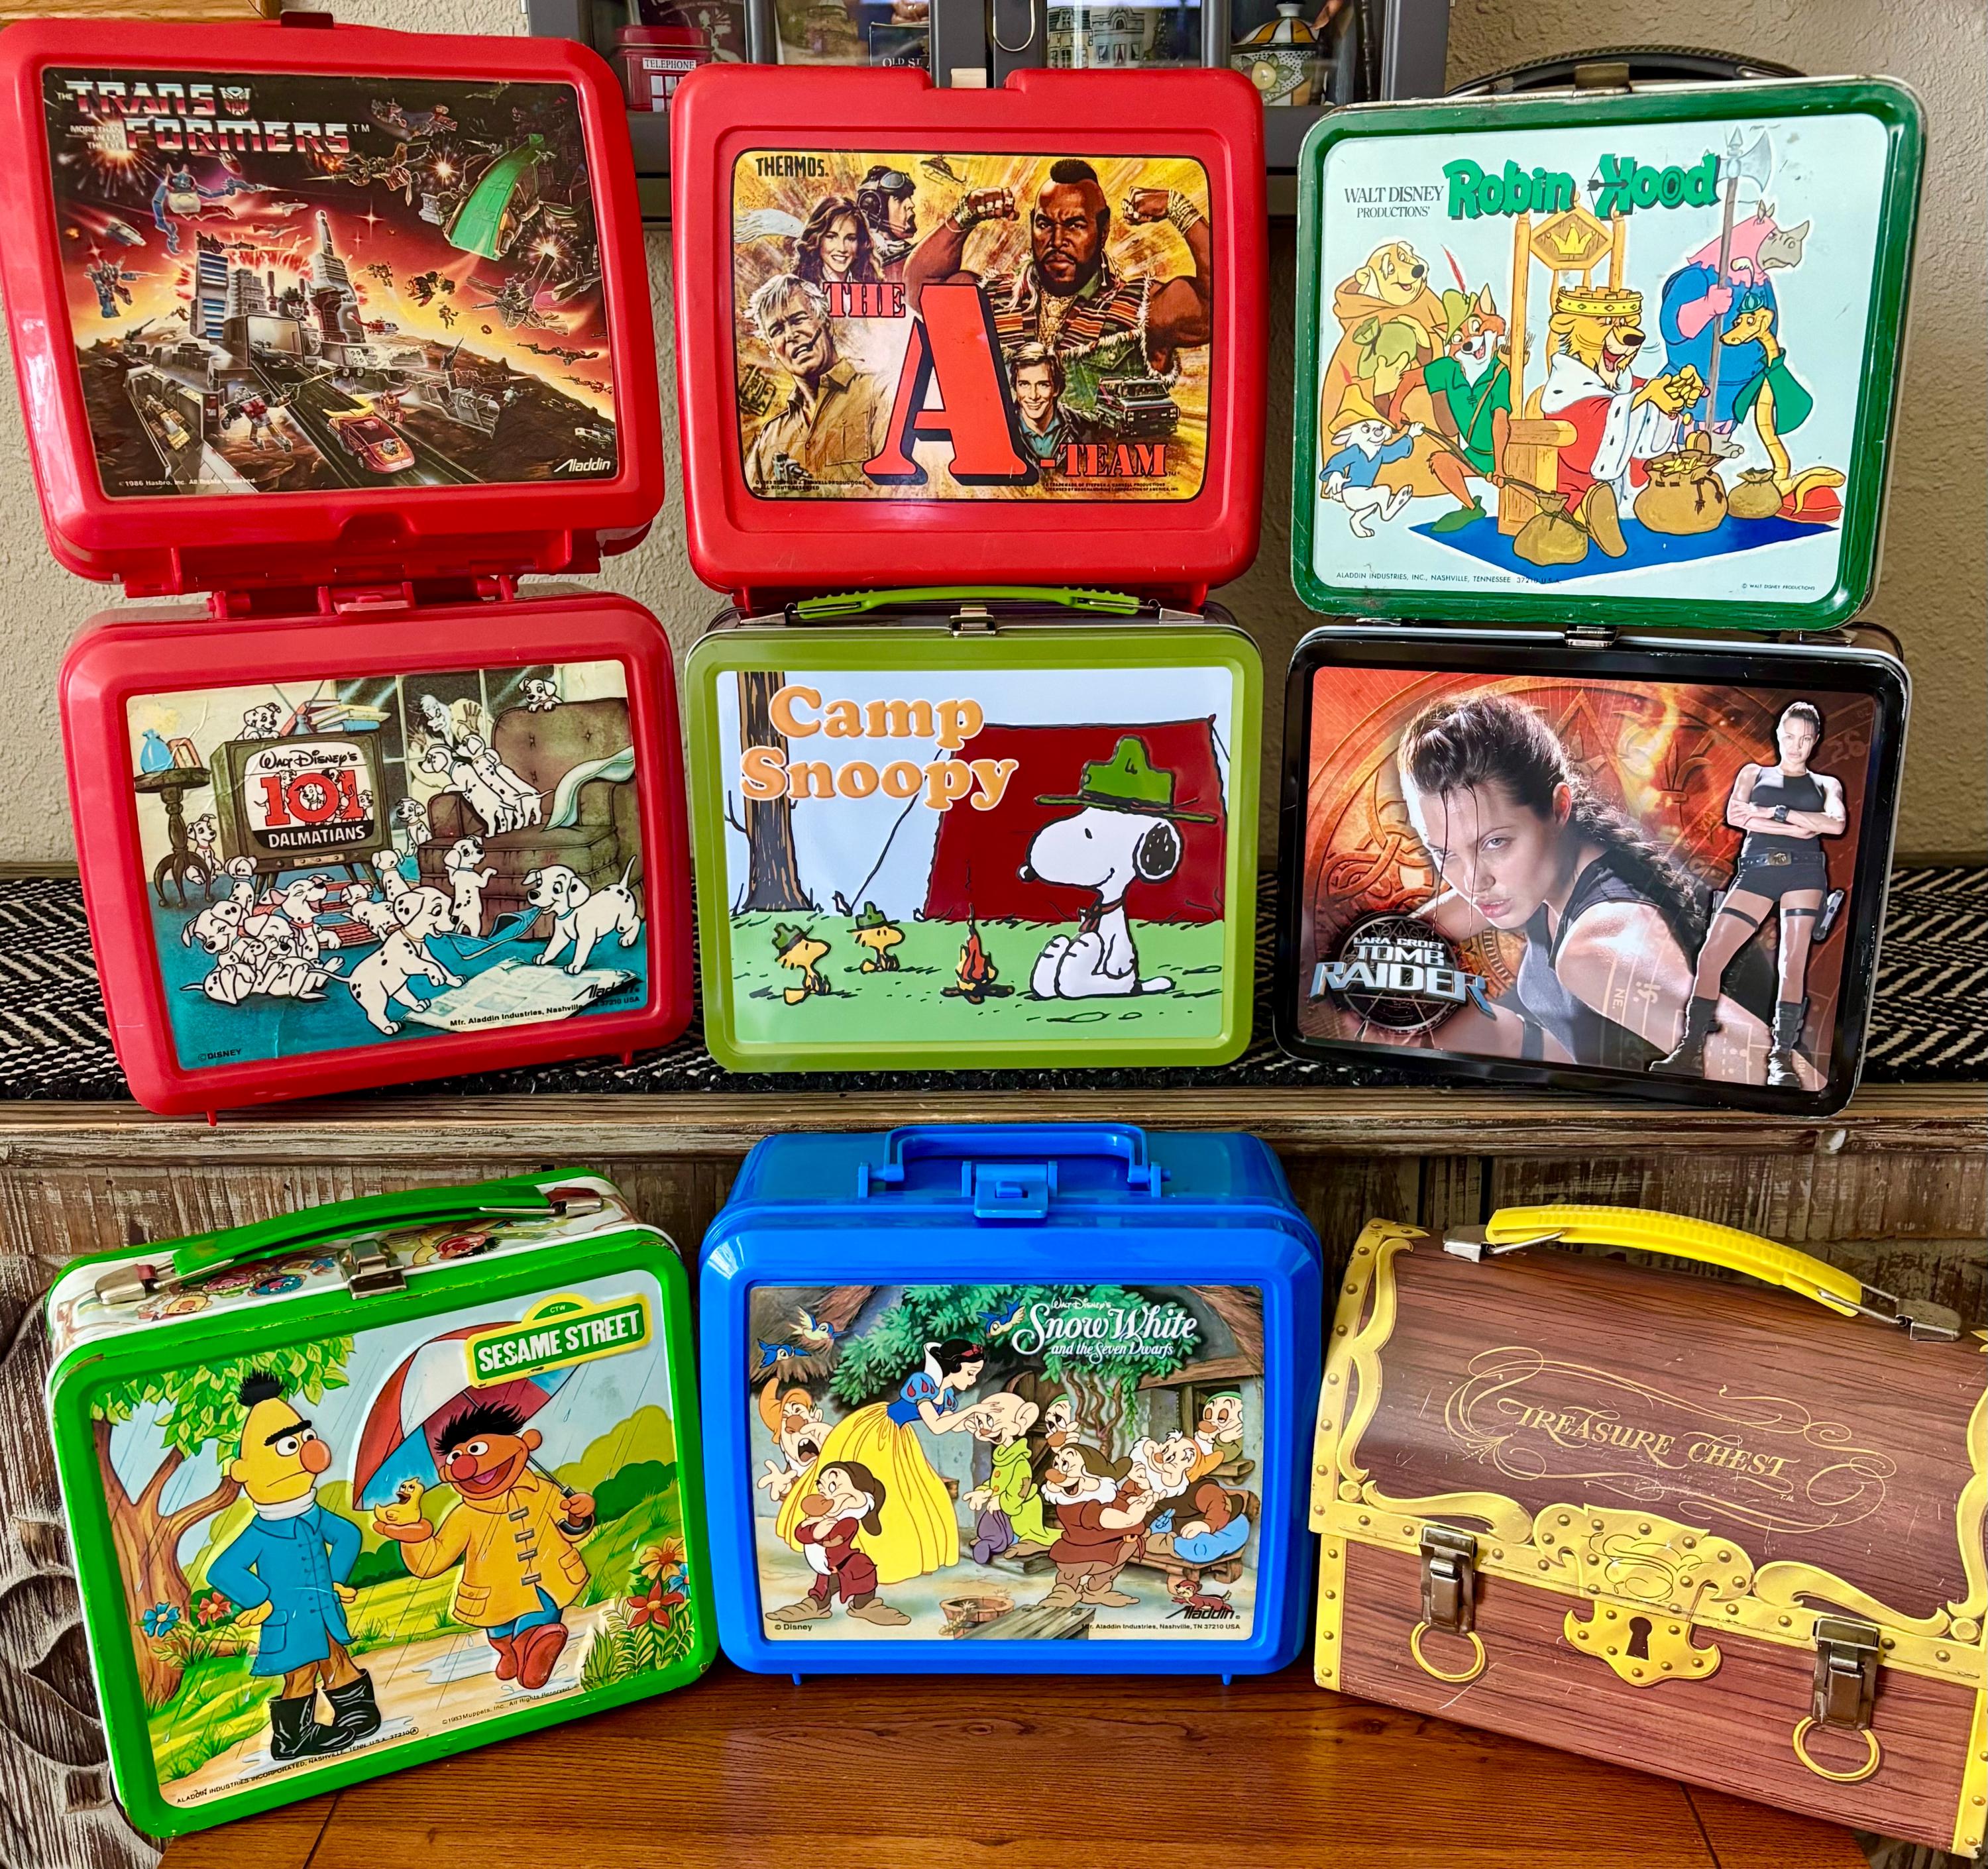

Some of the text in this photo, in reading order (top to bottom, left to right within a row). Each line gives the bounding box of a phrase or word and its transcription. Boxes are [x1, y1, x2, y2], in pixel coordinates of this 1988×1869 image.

[645, 59, 694, 70] TELEPHONE
[882, 57, 905, 67] OLD
[56, 80, 216, 115] THE TRANS
[124, 117, 370, 153] FORMERS TM
[1344, 185, 1445, 203] WALT DISNEY
[1442, 152, 1722, 221] Robin Hood
[823, 282, 906, 318] THE
[862, 283, 1034, 482] A
[553, 457, 611, 472] Aladdin
[1369, 572, 1409, 581] INDUSTRIES,
[1431, 574, 1470, 583] NASHVILLE,
[769, 685, 985, 751] Camp
[740, 745, 1020, 812] Snoopy
[260, 769, 365, 827] 101
[268, 825, 366, 849] DALMATIANS
[1353, 937, 1445, 949] LARA CROFT
[1353, 945, 1445, 967] TOMB
[1309, 961, 1498, 1021] RAIDER
[469, 1014, 500, 1024] Aladdin
[550, 1304, 566, 1313] CTW
[478, 1310, 639, 1372] SESAME STREET
[1011, 1303, 1197, 1356] Snow White
[1051, 1342, 1174, 1365] and the Seven Dwarfs
[1499, 1399, 1800, 1478] TREASURE CHEST
[1165, 1605, 1235, 1619] Aladdin
[783, 1623, 812, 1632] Disney
[209, 1778, 249, 1794] INDUSTRIES
